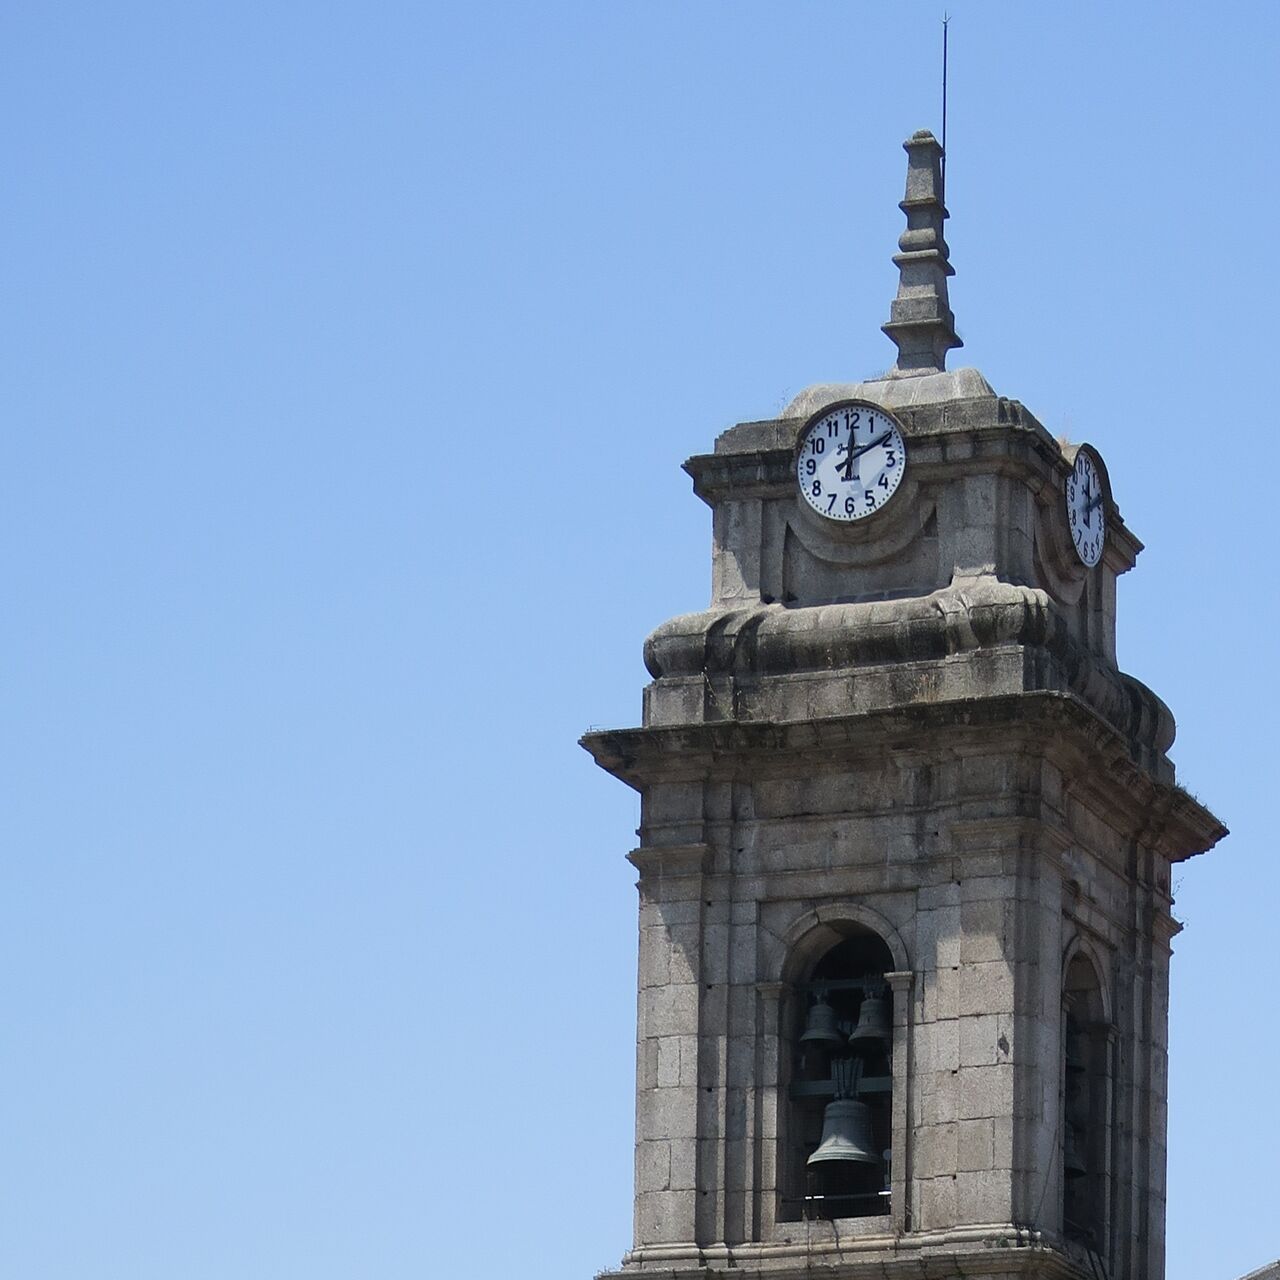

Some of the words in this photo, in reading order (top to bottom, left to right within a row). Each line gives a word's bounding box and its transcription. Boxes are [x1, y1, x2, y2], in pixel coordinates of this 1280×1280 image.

[826, 420, 838, 437] 11
[844, 412, 860, 430] 12
[868, 416, 874, 433] 1
[811, 438, 825, 454] 10
[806, 459, 816, 475] 9
[886, 450, 896, 467] 3
[811, 480, 821, 497] 8
[878, 473, 889, 489] 4
[827, 494, 837, 511] 7
[844, 497, 854, 514] 6
[865, 490, 875, 506] 5
